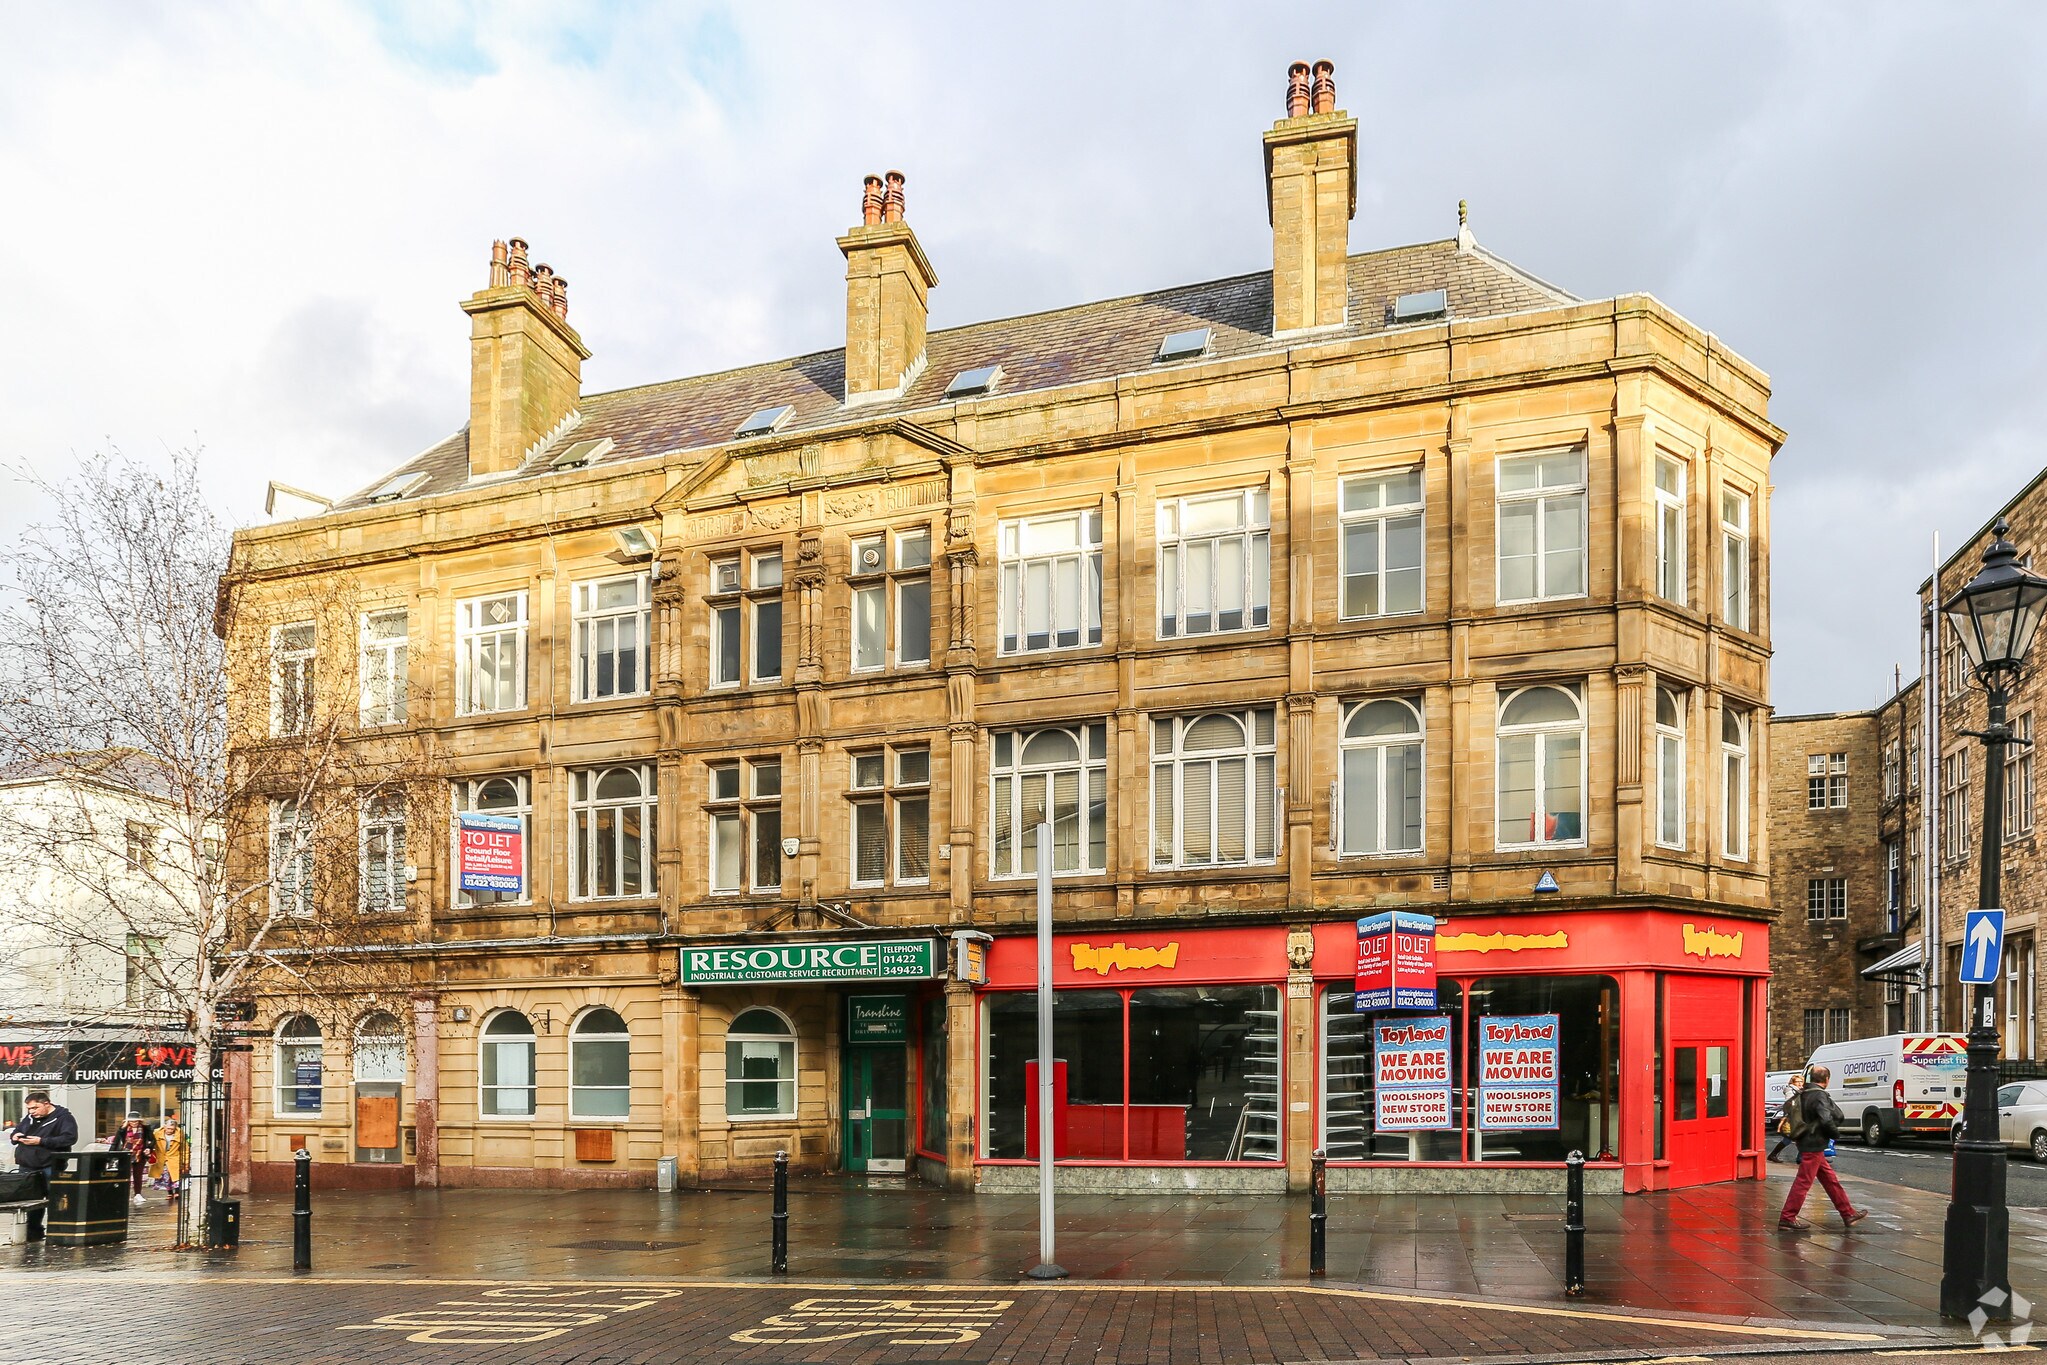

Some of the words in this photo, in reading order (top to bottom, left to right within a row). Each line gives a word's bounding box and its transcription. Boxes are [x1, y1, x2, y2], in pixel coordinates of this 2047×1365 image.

[687, 513, 744, 539] ARCADE
[886, 480, 949, 509] BUILDING
[464, 831, 485, 845] TO
[489, 834, 512, 847] LET
[464, 846, 492, 855] Ground
[493, 848, 511, 856] Floor
[464, 854, 512, 864] Retail/Leisure
[464, 879, 489, 887] 01422
[1359, 940, 1371, 956] TO
[1372, 936, 1387, 954] LET
[1398, 936, 1412, 952] TO
[1414, 937, 1430, 954] LET
[690, 946, 877, 971] RESOURCE
[883, 945, 923, 953] TELEPHONE
[883, 954, 916, 963] 01422
[691, 972, 735, 980] INDUSTRIAL
[746, 971, 787, 979] CUSTOMER
[790, 969, 820, 978] SERVICE
[822, 968, 877, 976] RECRUITMENT
[884, 966, 924, 975] 349423
[1357, 1000, 1370, 1008] 01422
[1371, 997, 1390, 1006] 430000
[1414, 998, 1434, 1006] 430000
[1986, 1001, 1991, 1010] 1
[856, 1004, 901, 1019] Transline
[1985, 1015, 1992, 1023] 2
[1380, 1025, 1446, 1045] Toyland
[1486, 1024, 1553, 1043] Toyland
[1381, 1054, 1408, 1067] WE
[1411, 1052, 1445, 1066] ARE
[1486, 1052, 1513, 1065] WE
[1516, 1051, 1552, 1064] ARE
[1912, 1055, 1954, 1065] Superfast
[1844, 1058, 1886, 1076] openreach
[5, 1072, 33, 1080] CARPET
[33, 1072, 62, 1080] CENTRE
[75, 1069, 142, 1080] FURNITURE
[145, 1069, 168, 1079] AND
[1381, 1067, 1446, 1080] MOVING
[1486, 1067, 1552, 1079] MOVING
[1382, 1092, 1445, 1101] WOOLSHOPS
[1486, 1092, 1551, 1100] WOOLSHOPS
[1382, 1105, 1407, 1113] NEW
[1410, 1104, 1445, 1112] STORE
[1487, 1104, 1512, 1112] NEW
[1515, 1103, 1551, 1112] STORE
[1382, 1116, 1418, 1124] COMING
[335, 1286, 684, 1344] STOP
[729, 1298, 1014, 1344] BUS
